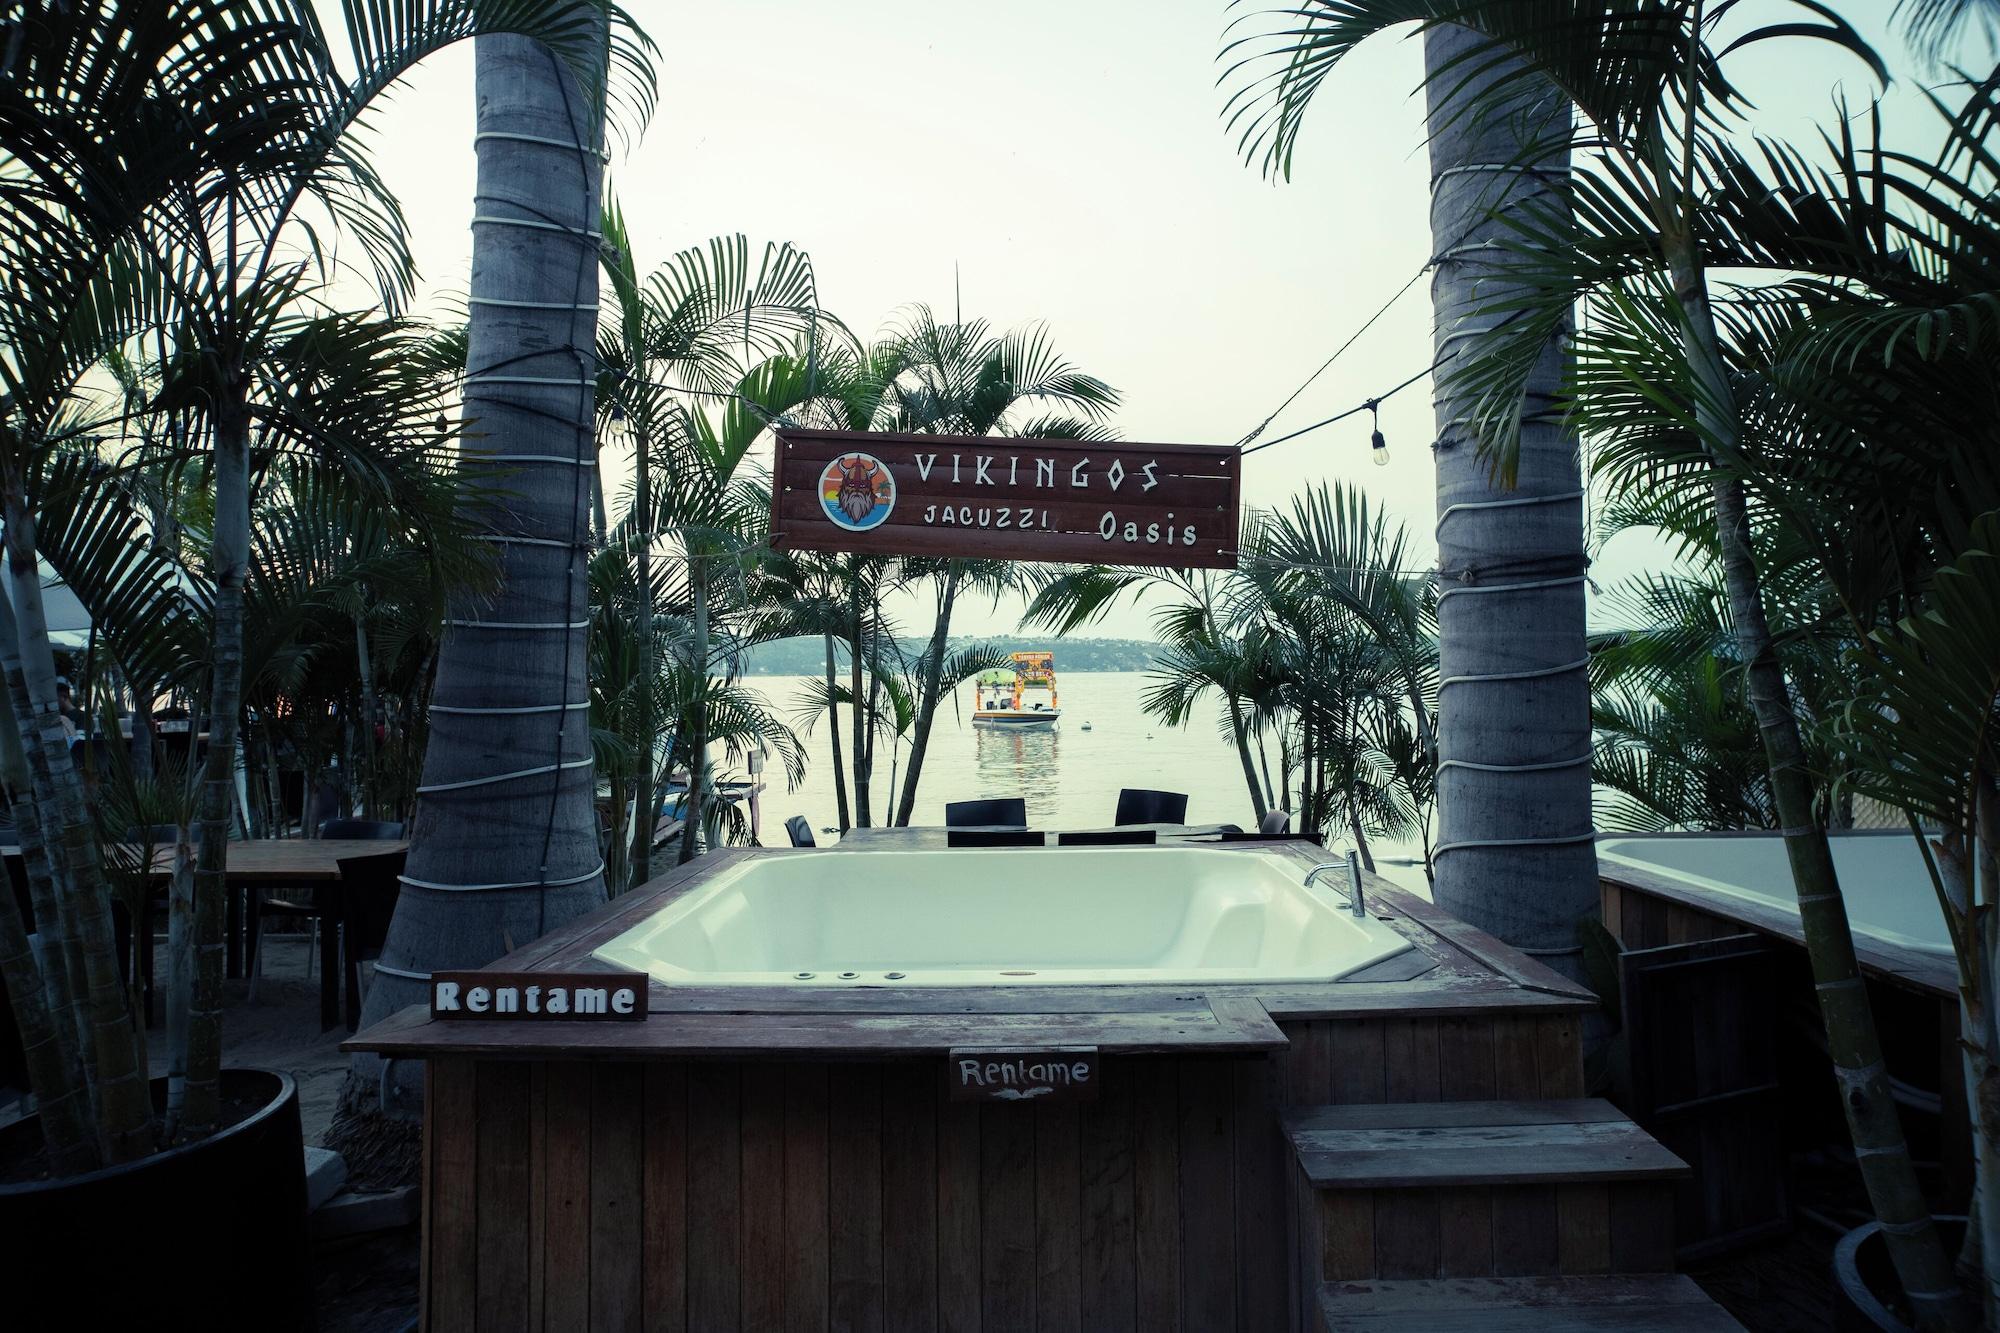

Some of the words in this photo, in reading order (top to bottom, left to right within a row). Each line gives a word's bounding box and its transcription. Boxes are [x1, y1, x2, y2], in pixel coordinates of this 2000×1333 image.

[914, 453, 1159, 493] VIKINGOS
[923, 504, 1049, 529] JACUZZI
[1099, 511, 1198, 547] Oasis
[435, 981, 636, 1014] Rentame
[958, 1059, 1090, 1087] Rentame
